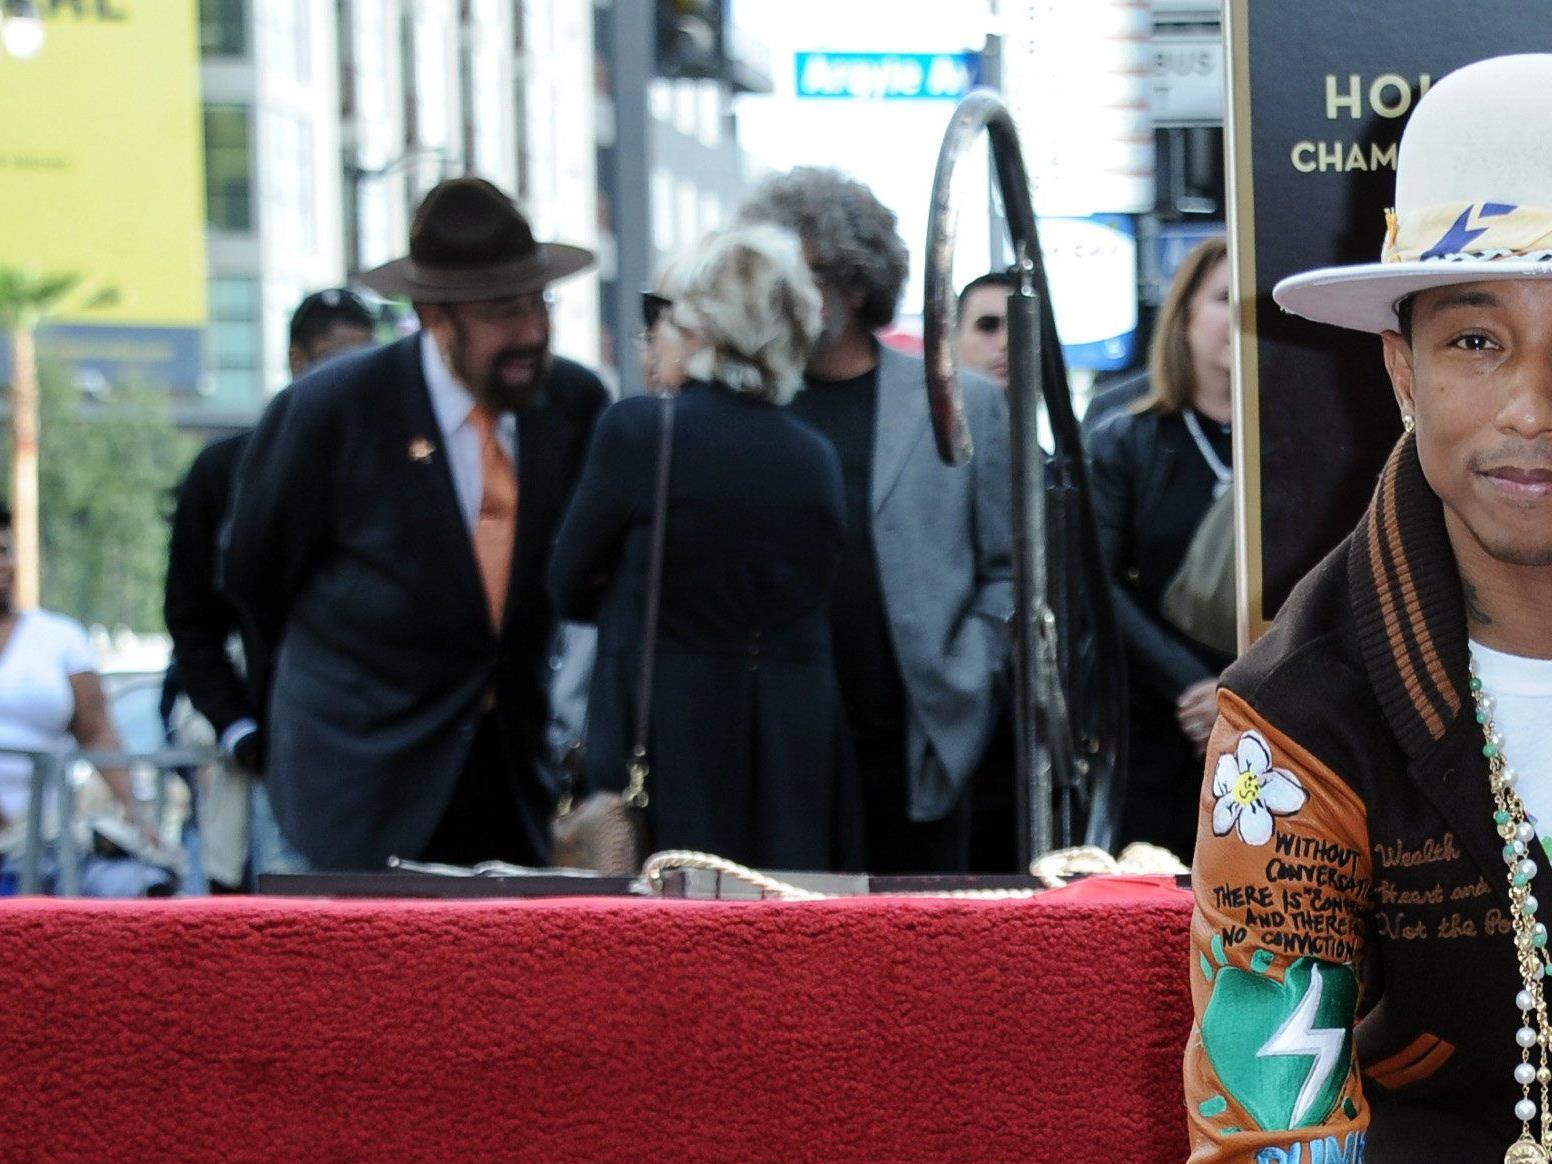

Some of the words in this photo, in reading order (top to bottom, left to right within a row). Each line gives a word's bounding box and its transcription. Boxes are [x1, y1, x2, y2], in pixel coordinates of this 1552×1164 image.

[1290, 141, 1397, 172] CHAM
[1275, 832, 1361, 877] WITHOUT
[1374, 832, 1461, 867] Wealth
[1213, 884, 1274, 908] THERE
[1246, 908, 1285, 928] AND
[1438, 913, 1478, 938] the
[1484, 908, 1513, 936] Po
[1222, 925, 1247, 948] NO
